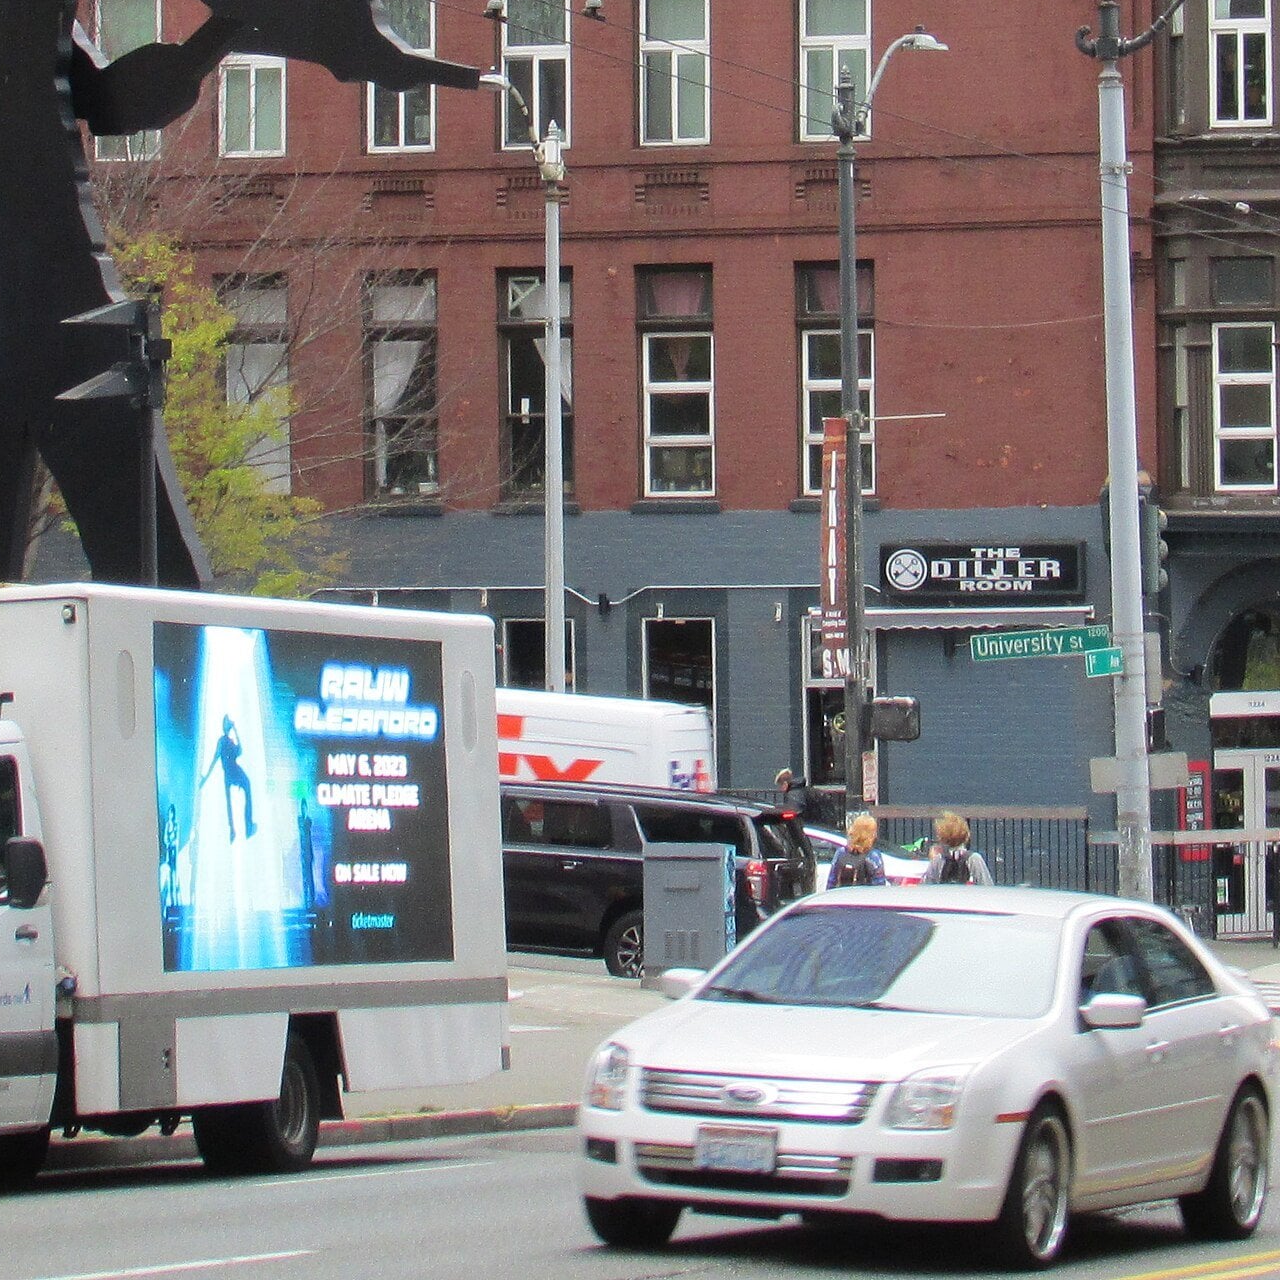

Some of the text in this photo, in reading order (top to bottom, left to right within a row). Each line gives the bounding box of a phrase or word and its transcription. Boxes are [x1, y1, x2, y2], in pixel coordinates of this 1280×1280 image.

[970, 548, 1021, 559] THE
[931, 560, 1061, 579] DILLER
[960, 580, 1033, 592] ROOM
[976, 632, 1064, 657] University
[1070, 635, 1083, 650] St
[321, 666, 410, 702] RAUW
[295, 701, 437, 736] ALEJANDRO
[327, 754, 356, 776] MAY
[373, 755, 407, 777] 2023
[318, 783, 419, 807] CLIMATE PLEDGE
[348, 808, 391, 831] ARENA
[335, 863, 407, 882] ON SALE NOW
[352, 912, 394, 929] ticketmaster
